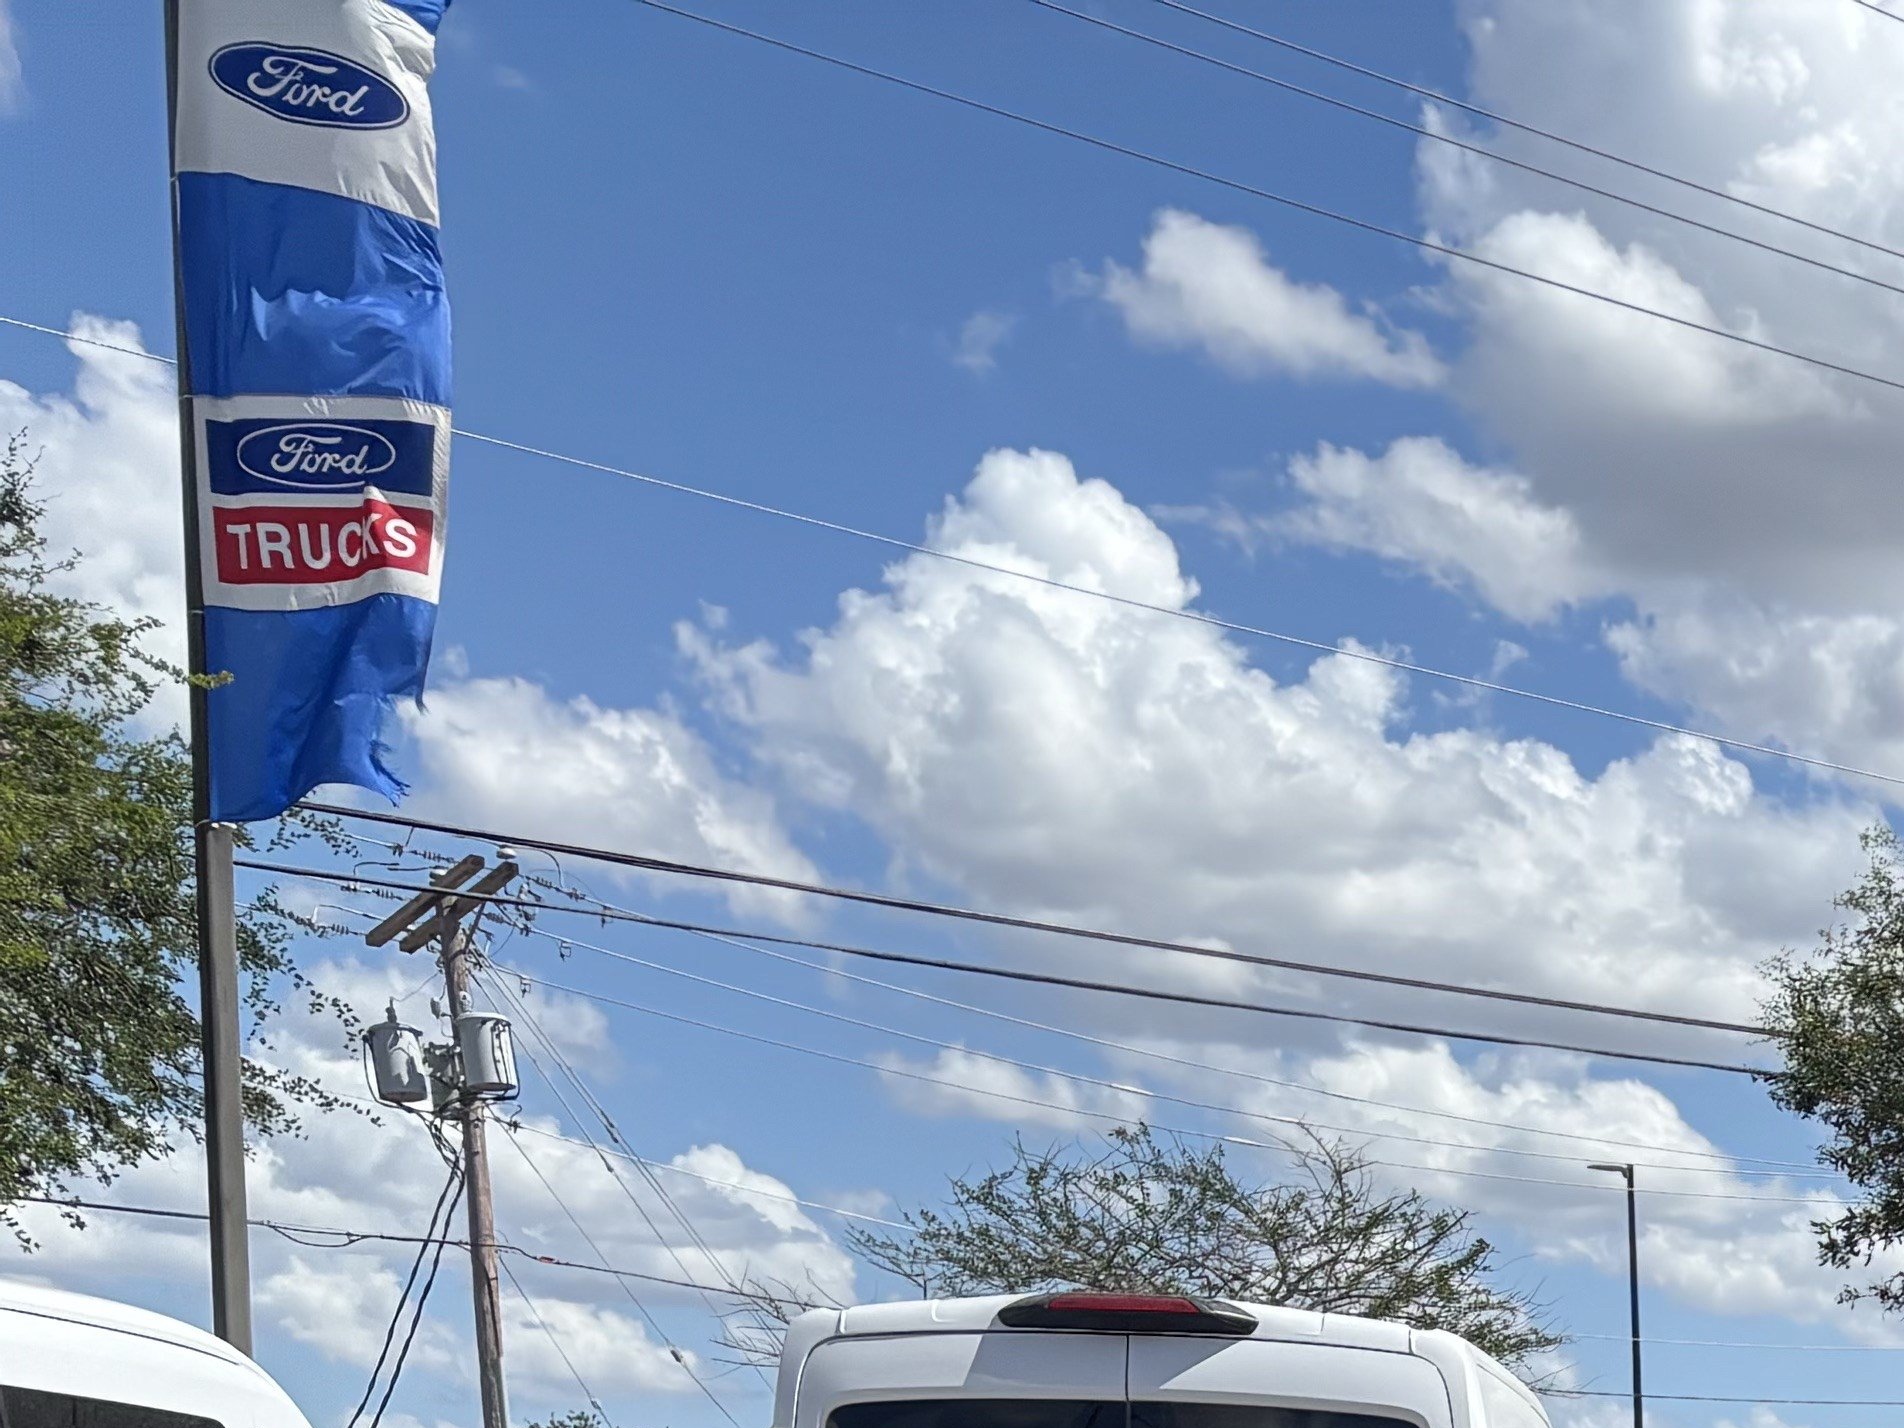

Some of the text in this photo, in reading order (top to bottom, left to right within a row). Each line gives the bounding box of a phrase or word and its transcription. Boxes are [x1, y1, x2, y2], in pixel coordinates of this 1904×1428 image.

[246, 53, 370, 119] Ford
[270, 431, 371, 477] Ford
[225, 512, 417, 572] TRUCKS
